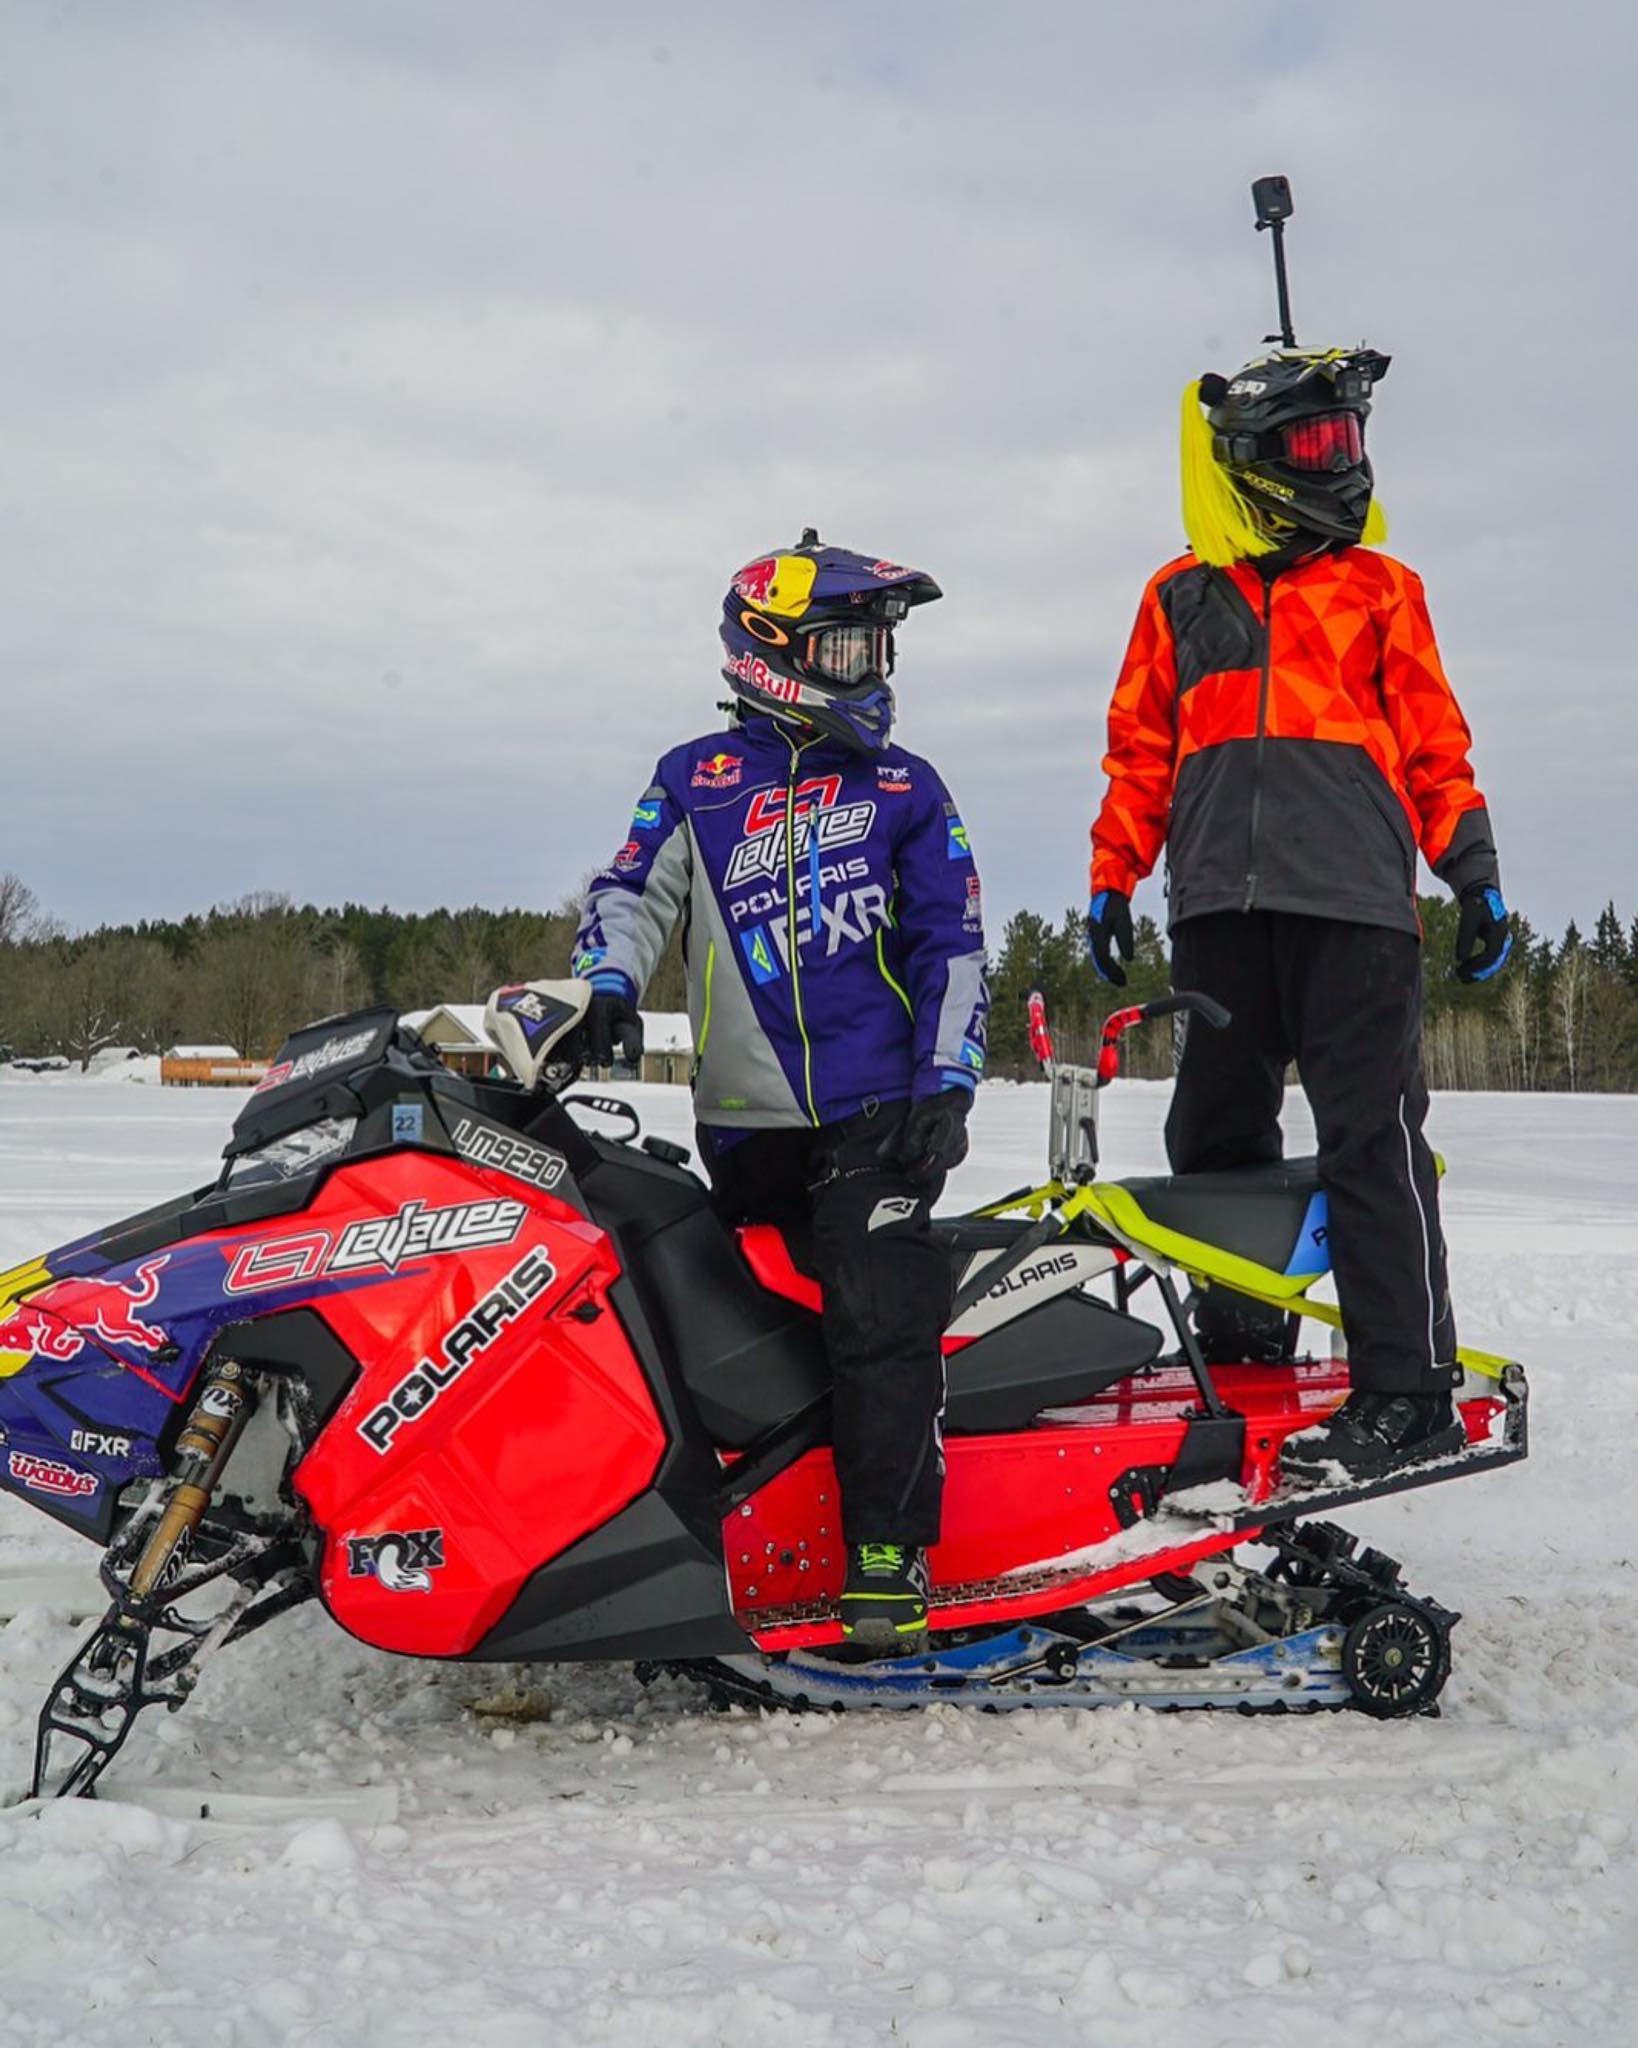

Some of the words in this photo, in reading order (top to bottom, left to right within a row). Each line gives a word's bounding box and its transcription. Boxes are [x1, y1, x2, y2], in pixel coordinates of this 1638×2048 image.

[751, 657, 801, 704] Bull
[395, 1116, 416, 1132] 22
[972, 1253, 1077, 1307] OLARIS
[357, 1248, 556, 1455] POLARIS
[83, 1433, 131, 1458] FXR
[347, 1529, 445, 1588] FOX
